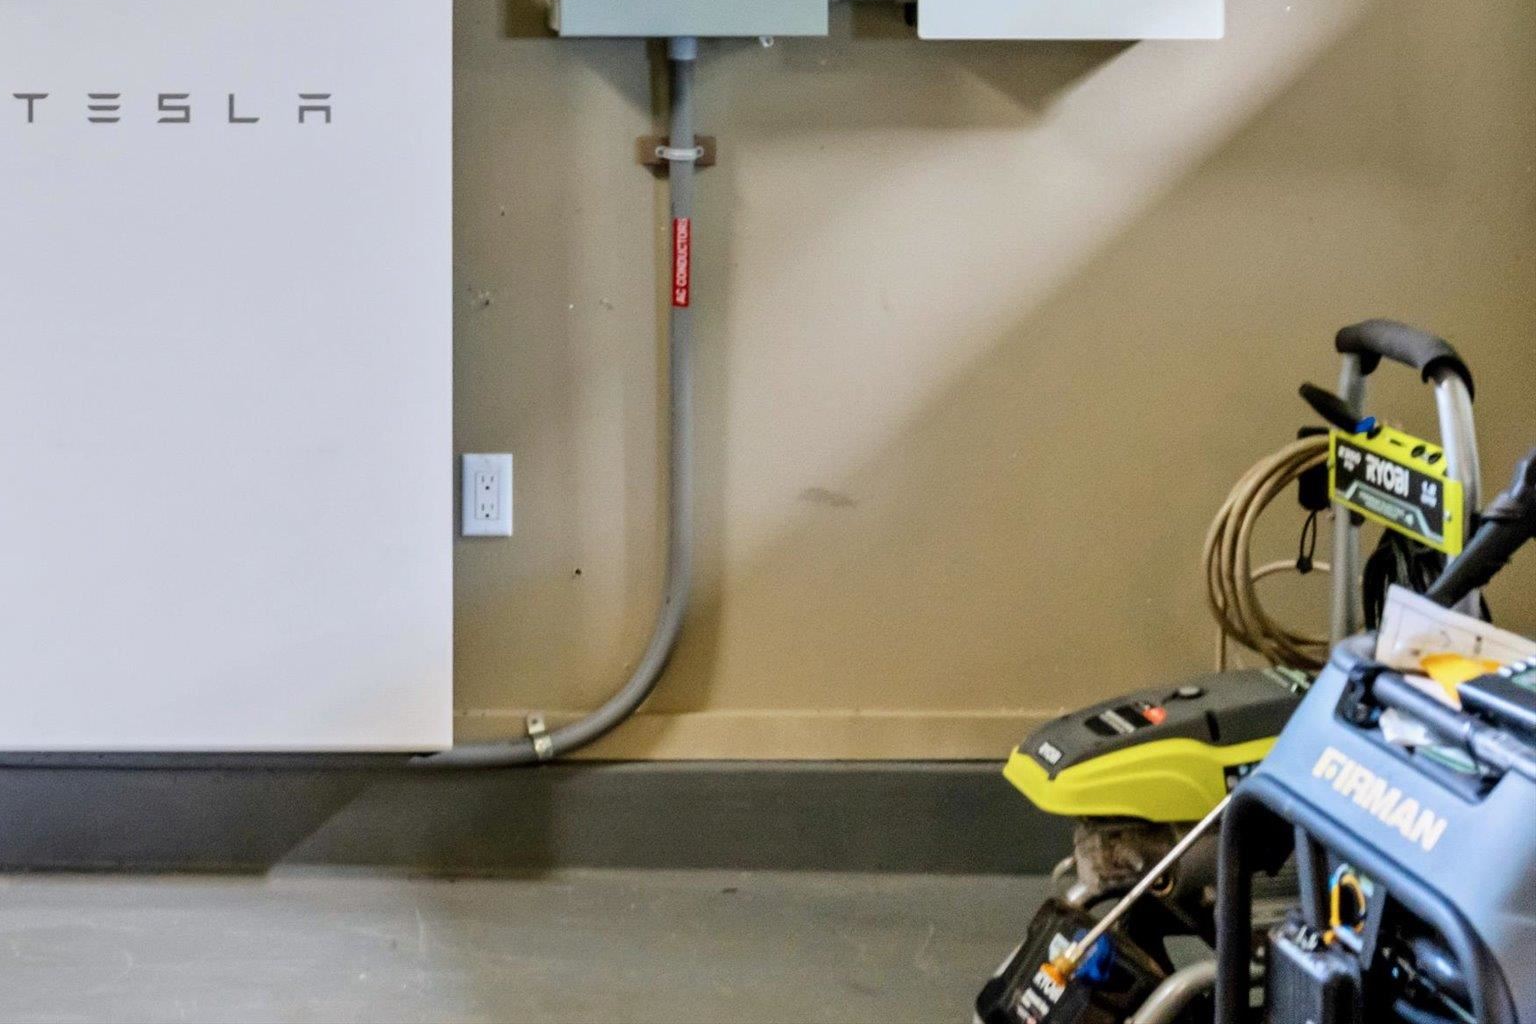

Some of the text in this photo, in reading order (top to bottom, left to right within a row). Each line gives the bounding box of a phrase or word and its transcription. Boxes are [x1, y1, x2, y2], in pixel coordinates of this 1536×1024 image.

[12, 93, 331, 123] TESLA
[676, 288, 687, 304] AC
[1365, 454, 1410, 497] RYOBI
[1312, 745, 1448, 853] FIRMAN
